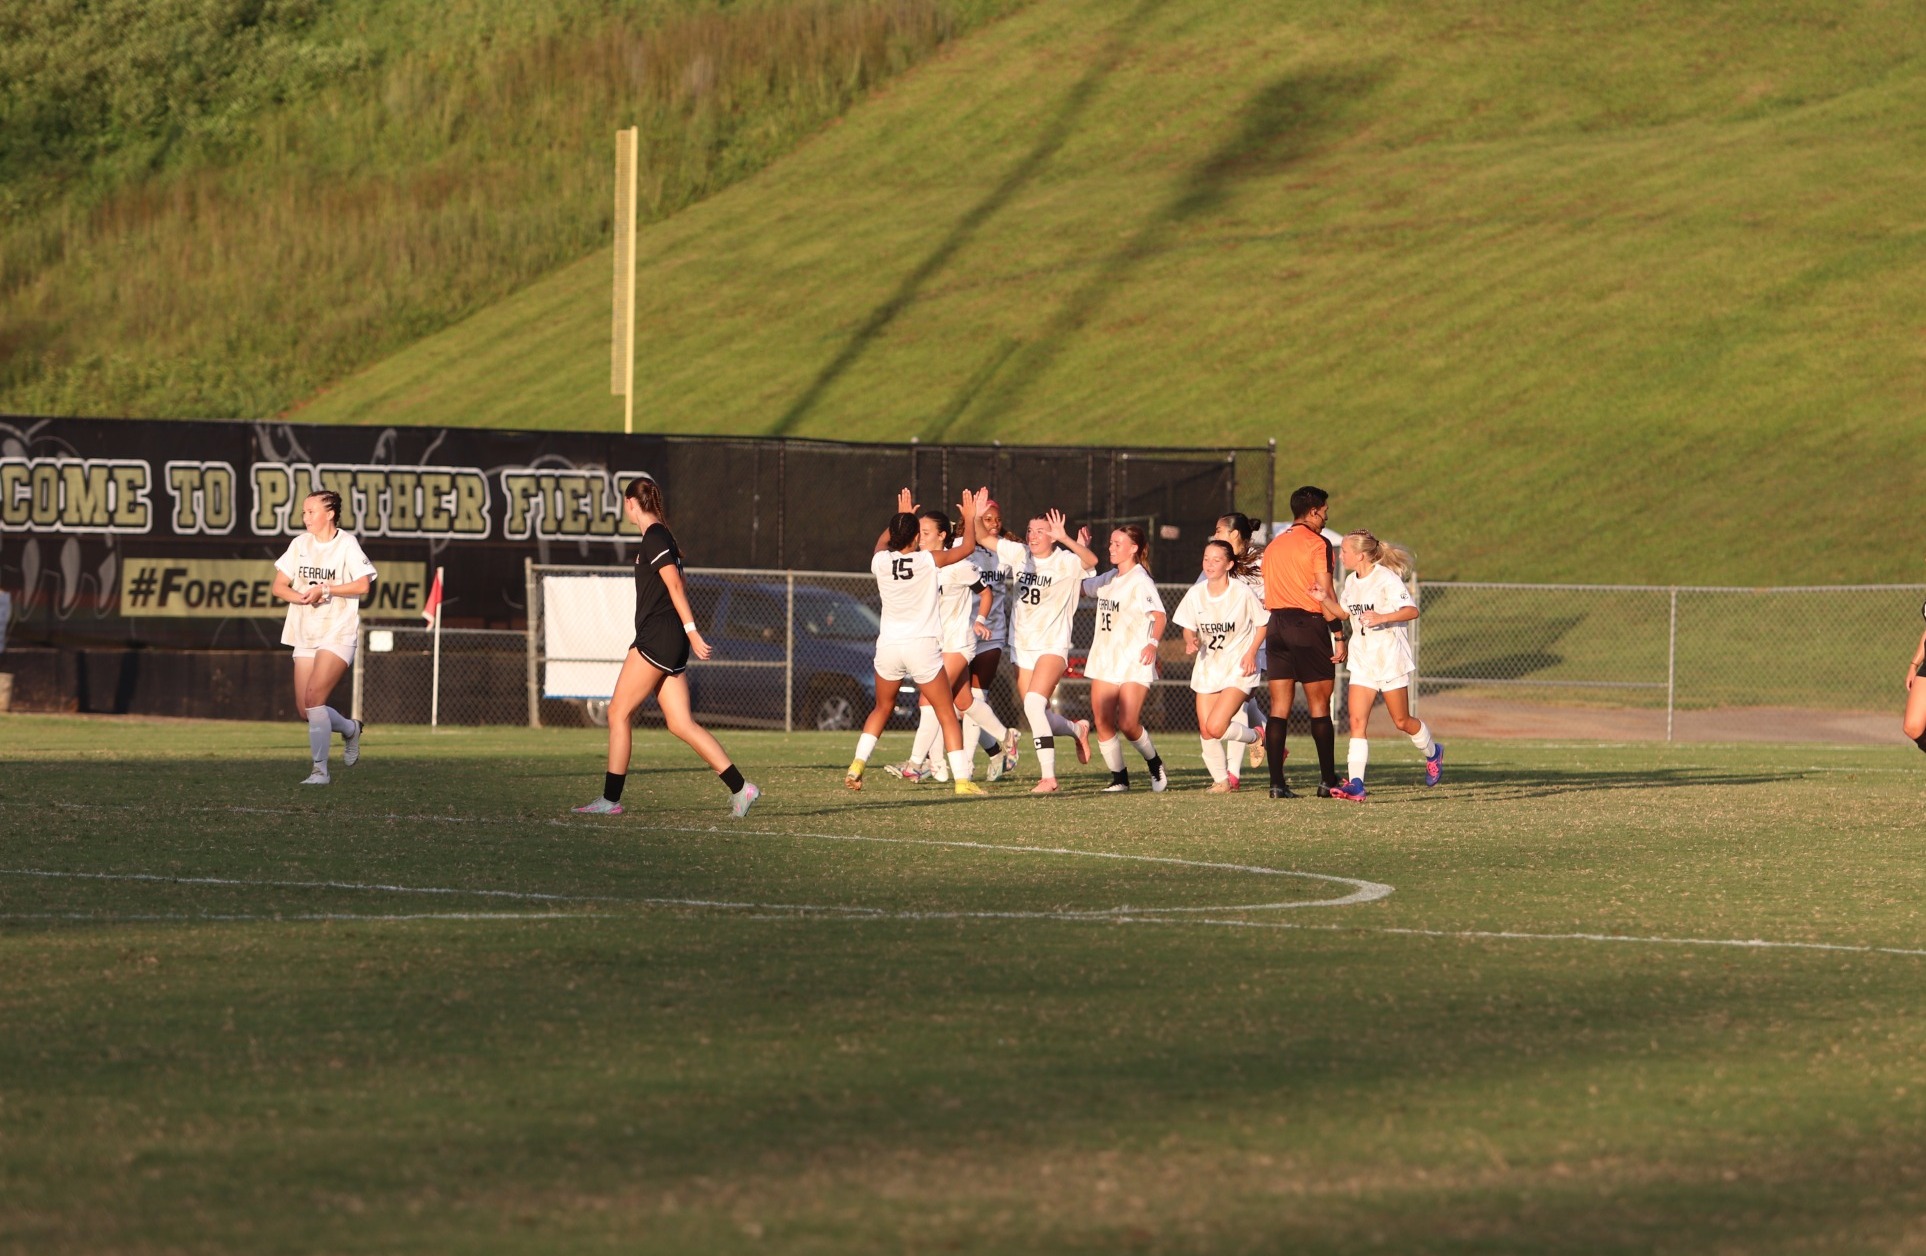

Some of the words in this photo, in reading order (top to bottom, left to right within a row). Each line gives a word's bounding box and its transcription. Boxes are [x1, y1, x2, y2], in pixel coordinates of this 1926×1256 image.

[0, 457, 152, 534] COME
[164, 460, 236, 535] TO
[299, 566, 336, 580] FERRUM
[891, 558, 914, 580] 15
[1020, 586, 1040, 605] 28
[1200, 622, 1235, 634] FERRUM
[1208, 634, 1226, 650] 22
[1033, 738, 1042, 749] C
